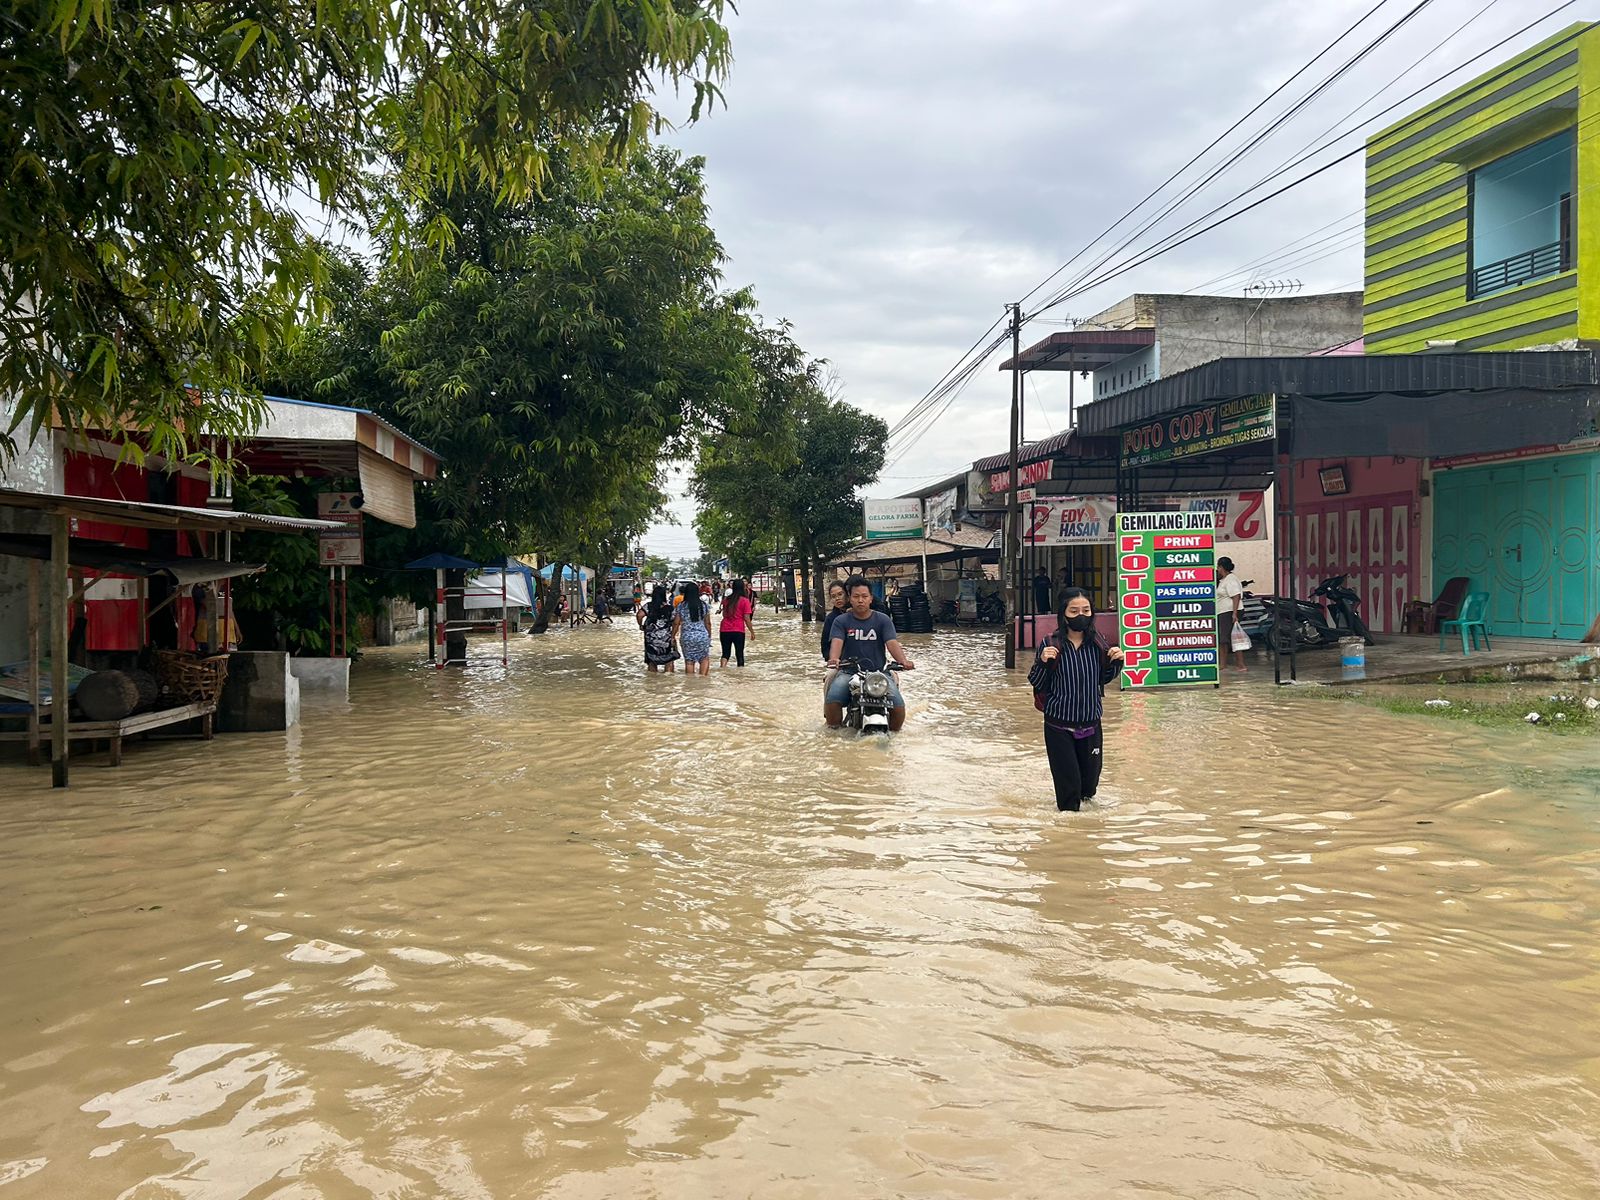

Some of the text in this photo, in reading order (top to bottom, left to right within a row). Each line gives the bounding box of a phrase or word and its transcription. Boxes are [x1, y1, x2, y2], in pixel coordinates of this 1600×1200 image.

[1220, 393, 1273, 418] GEMILANG JAYA
[1123, 422, 1163, 455] FOTO
[1169, 407, 1217, 444] COPY
[1210, 434, 1233, 448] BROWSING
[1234, 430, 1250, 444] TUGAS
[1250, 425, 1274, 440] SEKOLAH
[1021, 460, 1050, 485] CINDY
[878, 503, 919, 513] APOTEK
[1189, 499, 1227, 513] HASAN
[1061, 508, 1086, 523] EDY
[1234, 491, 1264, 539] 2
[1024, 506, 1050, 542] 2
[1121, 514, 1183, 531] GEMILANG
[1186, 513, 1212, 529] JAYA
[1059, 522, 1100, 537] HASAN
[1164, 536, 1201, 547] PRINT
[1166, 553, 1199, 564] SCAN
[1173, 570, 1196, 580] ATK
[1157, 587, 1211, 596] PAS PHOTO
[1120, 535, 1152, 686] FOTOCOPY
[1172, 603, 1202, 614] JILID
[1159, 619, 1212, 630] MATERAI
[848, 628, 877, 640] FILA
[1157, 636, 1212, 647] JAM DINDING
[1158, 652, 1214, 664] BINGKAI FOTO
[1177, 669, 1200, 679] DLL
